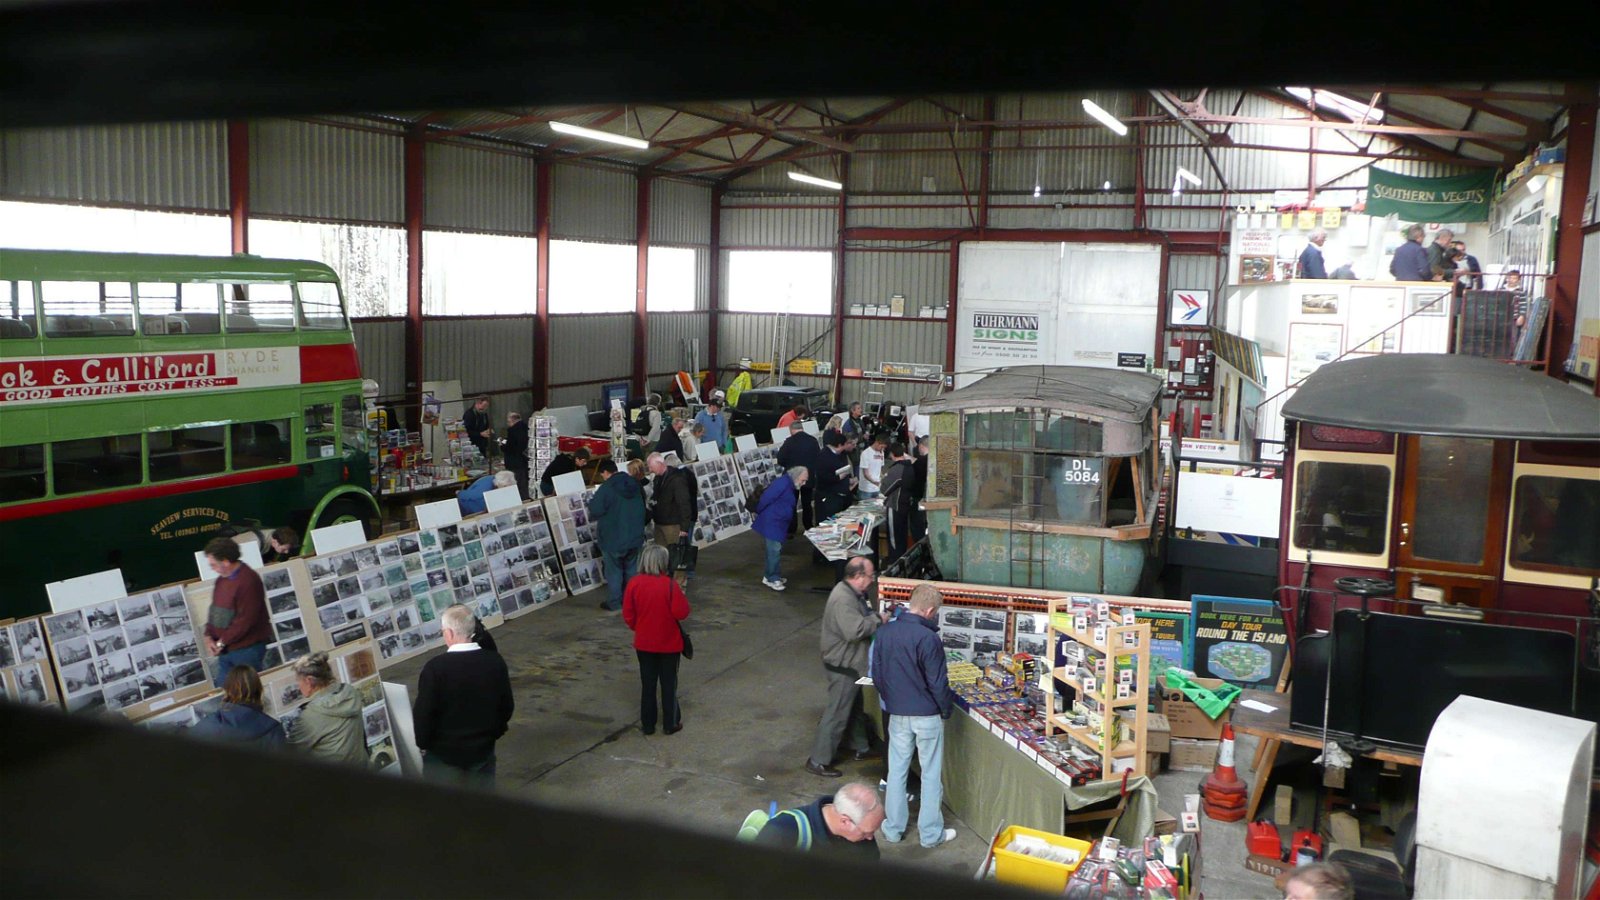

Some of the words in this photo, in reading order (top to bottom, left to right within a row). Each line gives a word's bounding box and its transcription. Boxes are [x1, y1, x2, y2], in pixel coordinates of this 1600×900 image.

[1372, 183, 1435, 201] SOUTHERN
[1442, 188, 1484, 204] VECTIS
[974, 314, 1038, 330] FUHRMANN
[974, 328, 1038, 340] SIGNS
[227, 350, 279, 364] RYDE
[52, 368, 71, 385] &
[81, 355, 209, 383] Culliford
[227, 365, 280, 375] SHANKLIN
[5, 389, 52, 401] GOOD
[63, 384, 127, 397] CLOTHES
[138, 381, 176, 393] COST
[1072, 459, 1091, 471] DL
[1064, 470, 1100, 484] 5084
[150, 511, 181, 536] SEAVIEW
[182, 507, 216, 518] SERVICES
[1155, 619, 1176, 628] HERE
[1220, 613, 1237, 621] HERE
[1220, 621, 1238, 629] DAY
[1241, 622, 1263, 631] TOUR
[1196, 627, 1229, 640] ROUND
[1231, 629, 1250, 641] THE
[1251, 632, 1288, 645] ISLAND
